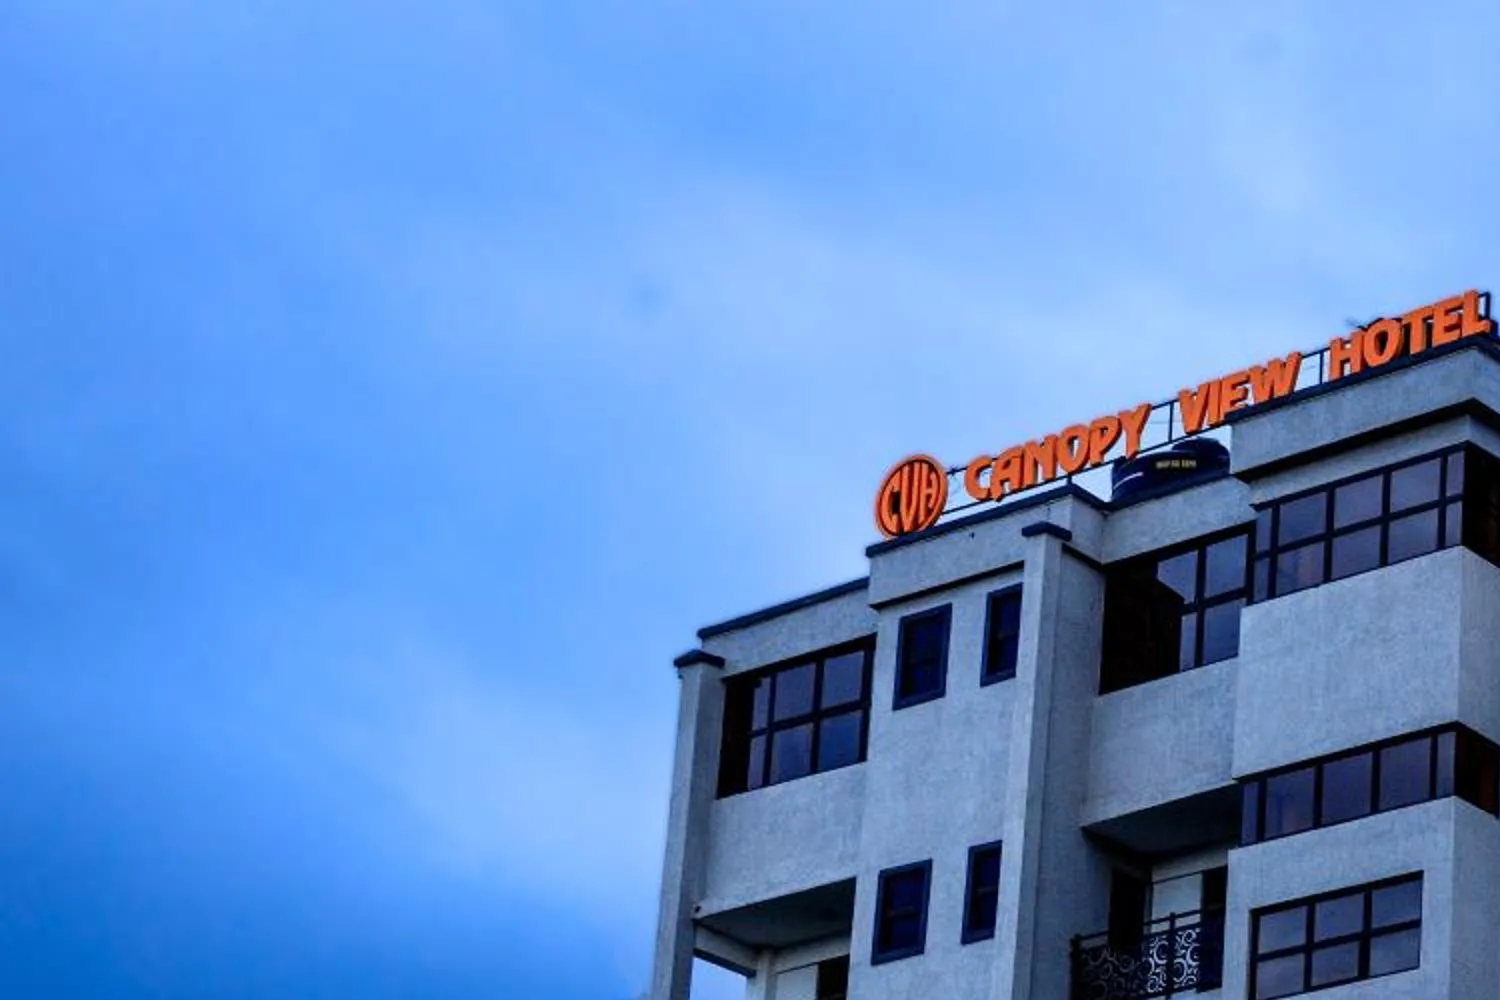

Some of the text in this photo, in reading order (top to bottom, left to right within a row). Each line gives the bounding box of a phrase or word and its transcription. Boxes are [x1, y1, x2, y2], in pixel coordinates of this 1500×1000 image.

[964, 289, 1491, 501] CANOPY VIEW HOTEL
[879, 459, 942, 535] CVH
